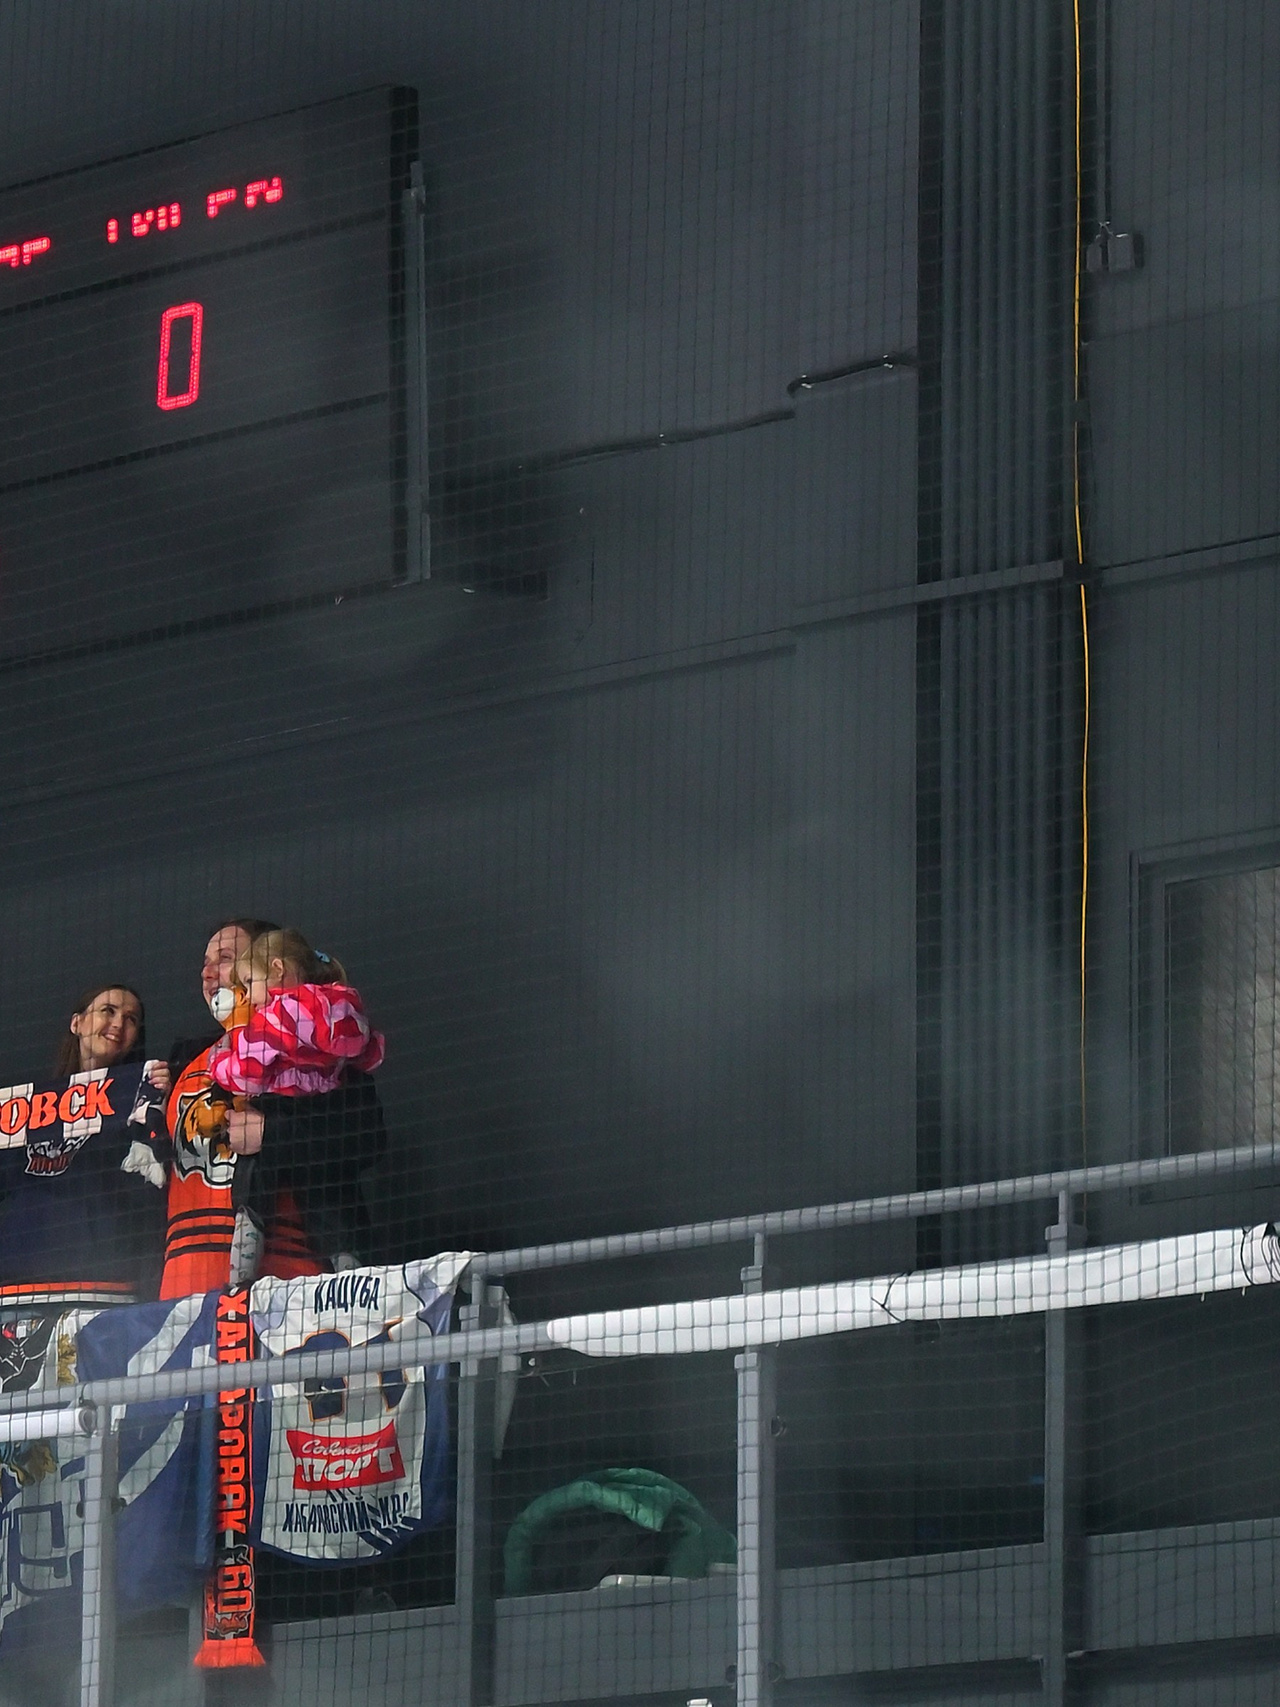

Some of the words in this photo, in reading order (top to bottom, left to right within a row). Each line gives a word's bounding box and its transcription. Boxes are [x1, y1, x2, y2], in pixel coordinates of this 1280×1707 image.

[157, 302, 203, 410] 0
[314, 1275, 381, 1314] КАЦУБА
[218, 1564, 253, 1614] 60
